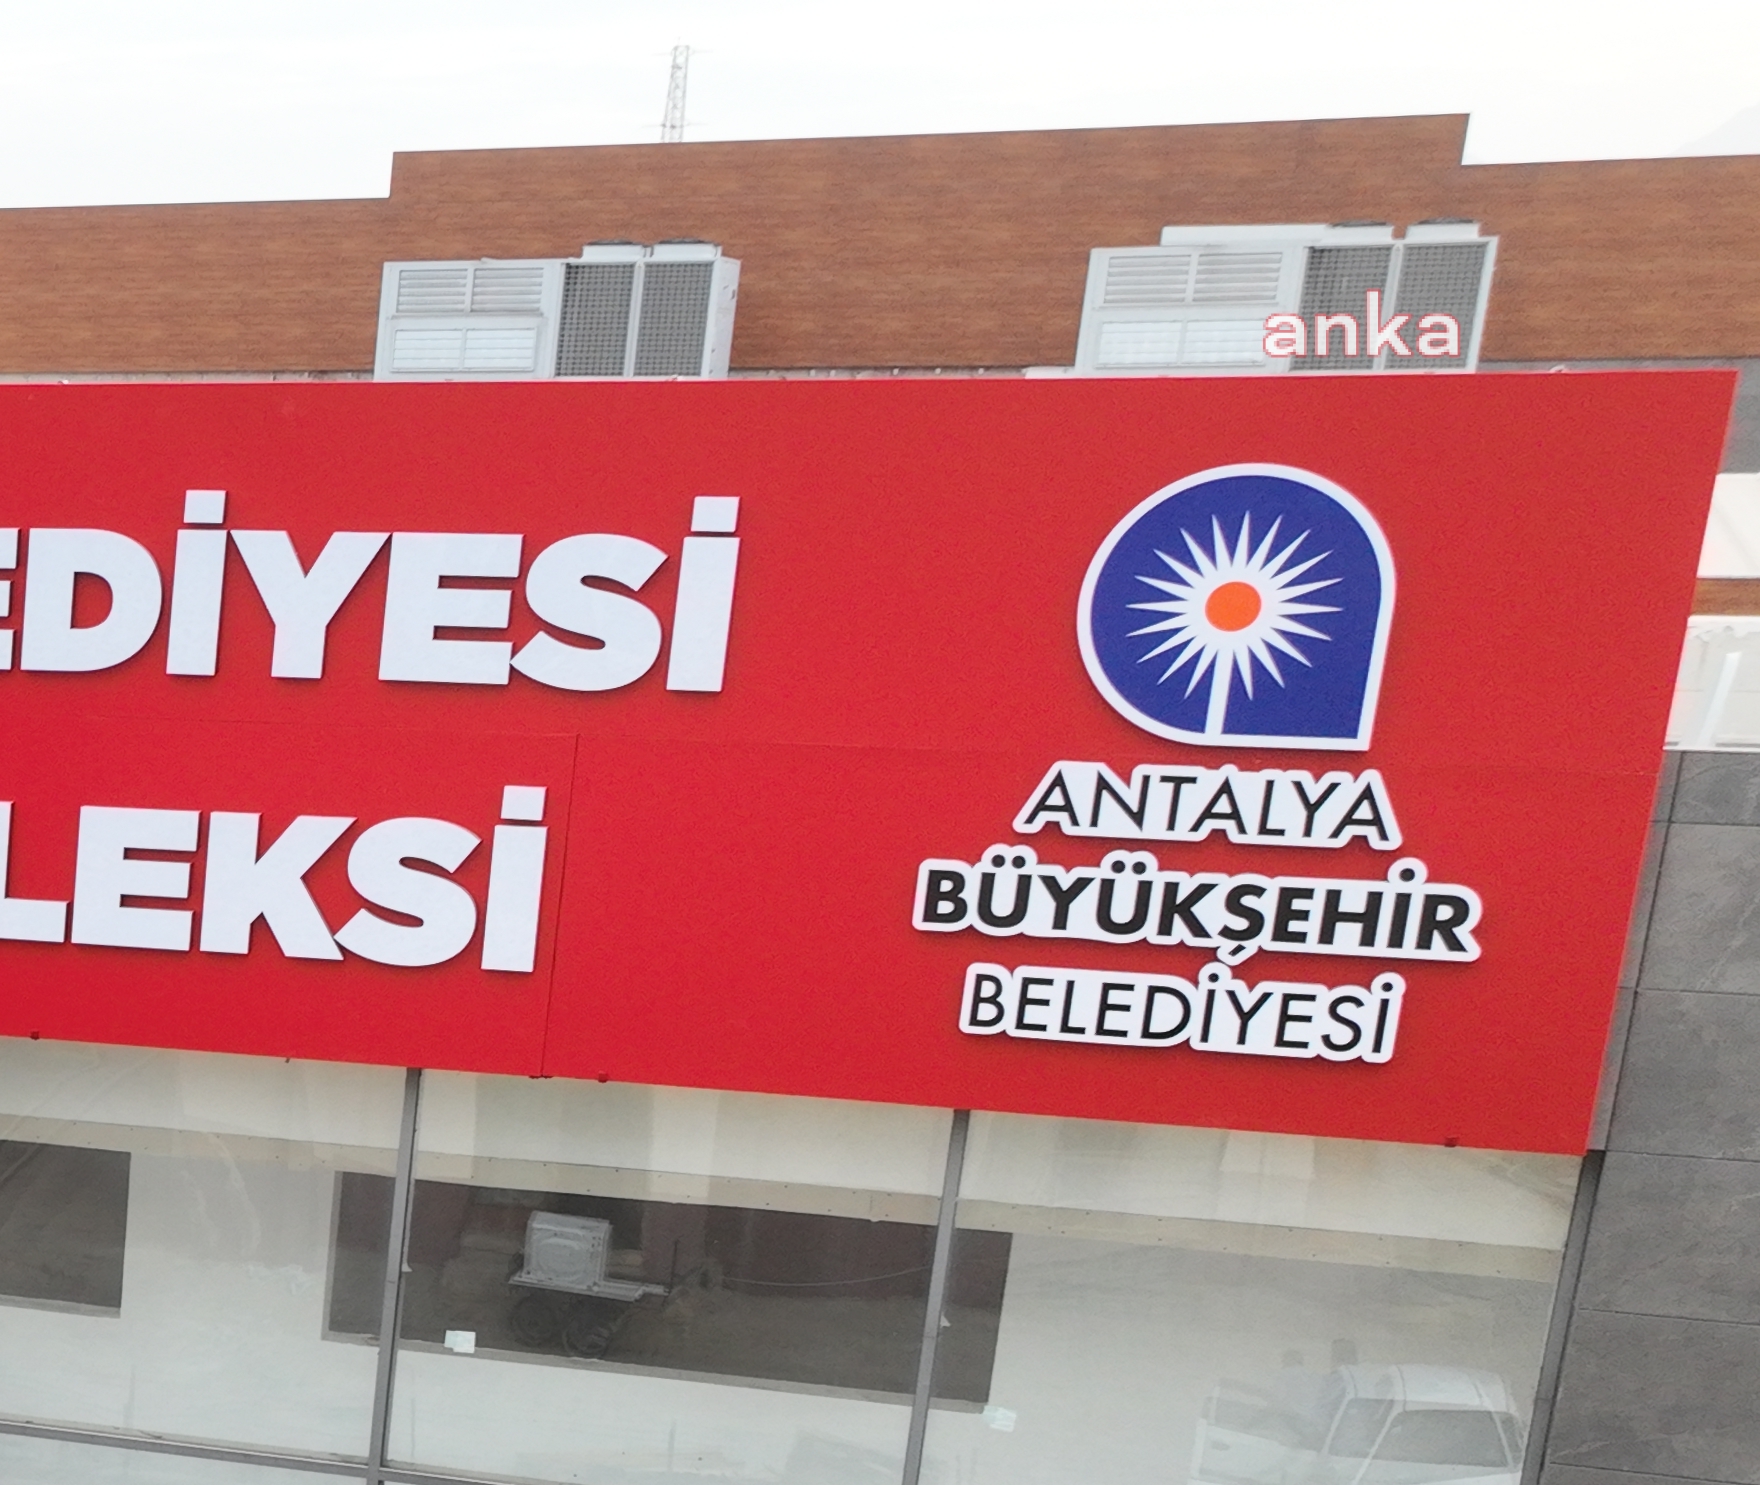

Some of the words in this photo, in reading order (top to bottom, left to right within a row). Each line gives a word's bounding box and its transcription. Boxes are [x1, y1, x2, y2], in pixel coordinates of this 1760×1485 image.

[1023, 768, 1390, 842] ANTALYA
[921, 853, 1471, 957] BÜYÜKŞEHİR
[967, 972, 1395, 1054] BELEDİYESİ
